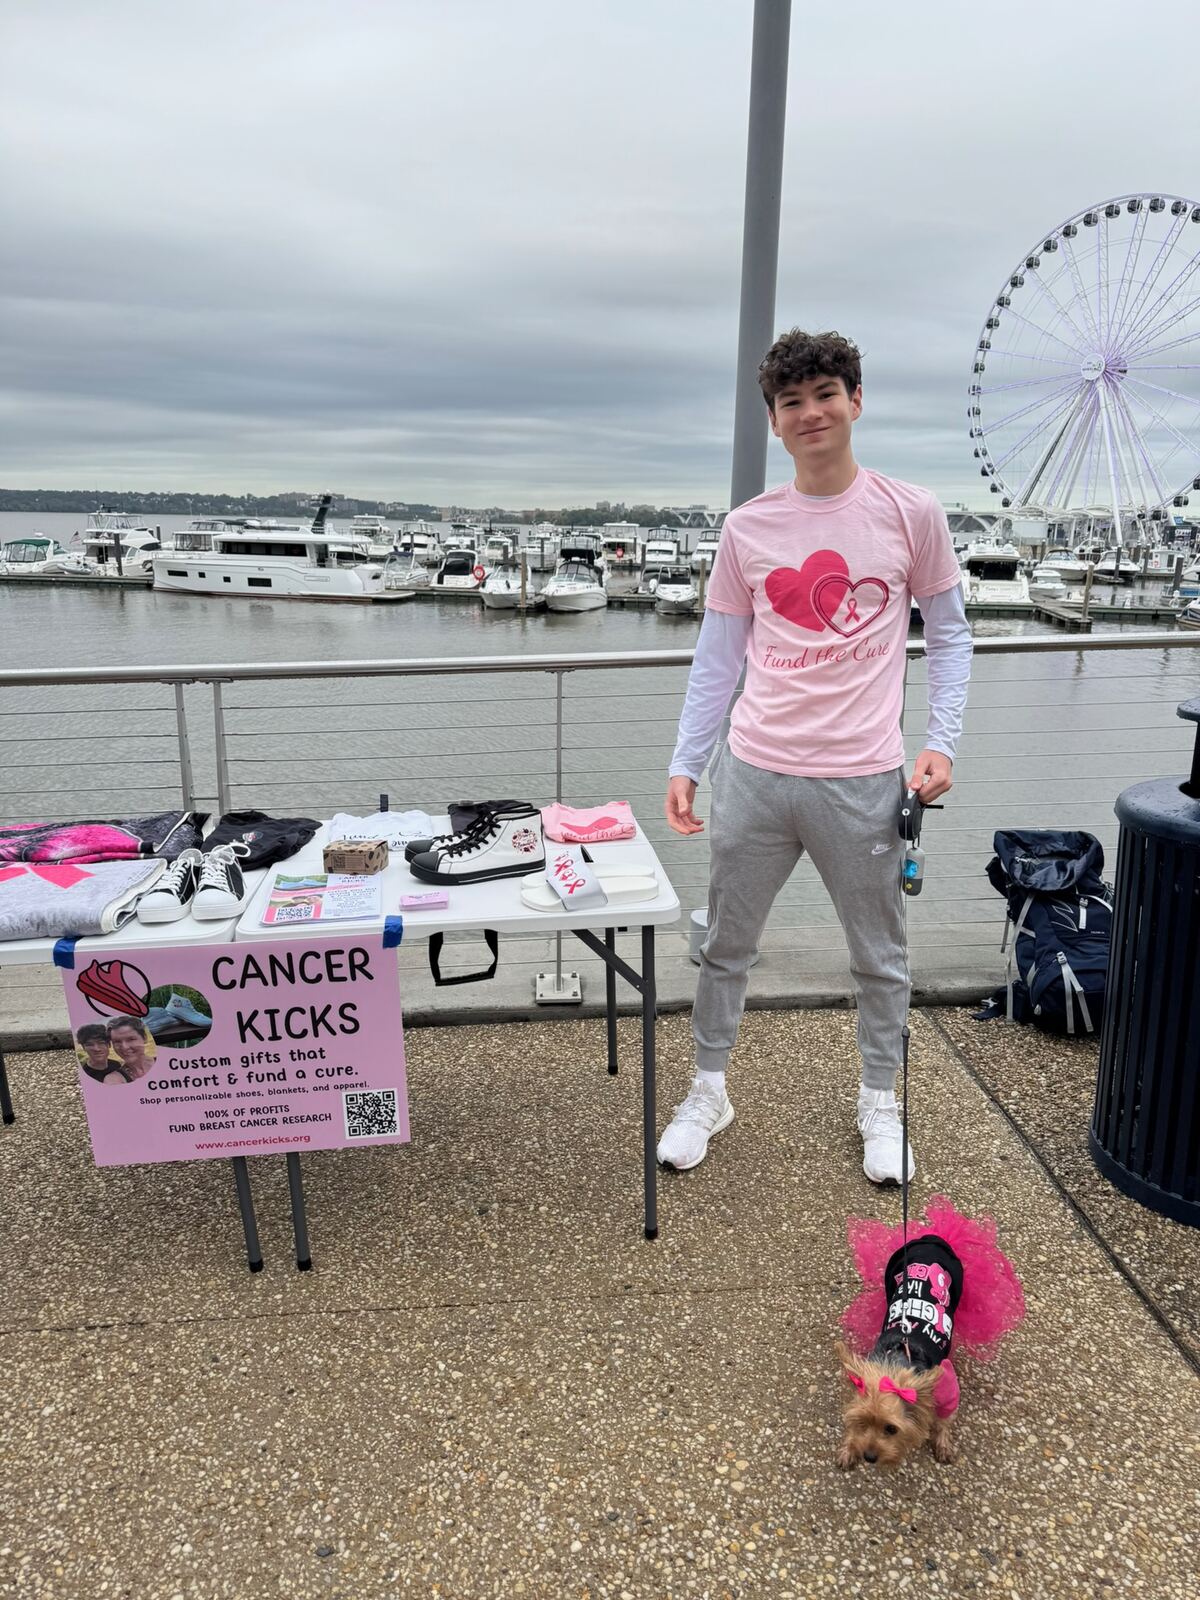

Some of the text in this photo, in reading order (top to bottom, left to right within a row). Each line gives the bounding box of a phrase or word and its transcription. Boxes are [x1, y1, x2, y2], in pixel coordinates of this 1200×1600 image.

[763, 637, 890, 668] Fund the Cure
[211, 947, 374, 990] CANCER
[236, 1002, 360, 1044] KICKS
[169, 1047, 326, 1070] Custom gifts that
[148, 1065, 359, 1090] comfort & fund a cure.
[139, 1081, 370, 1105] Shop personalizable shoes, blankets, and apparel.
[169, 1113, 332, 1133] FUND BREAST CANCER RESEARCH
[204, 1105, 290, 1119] 100% OF PROFITS
[195, 1135, 311, 1150] www.cancerkicks.org
